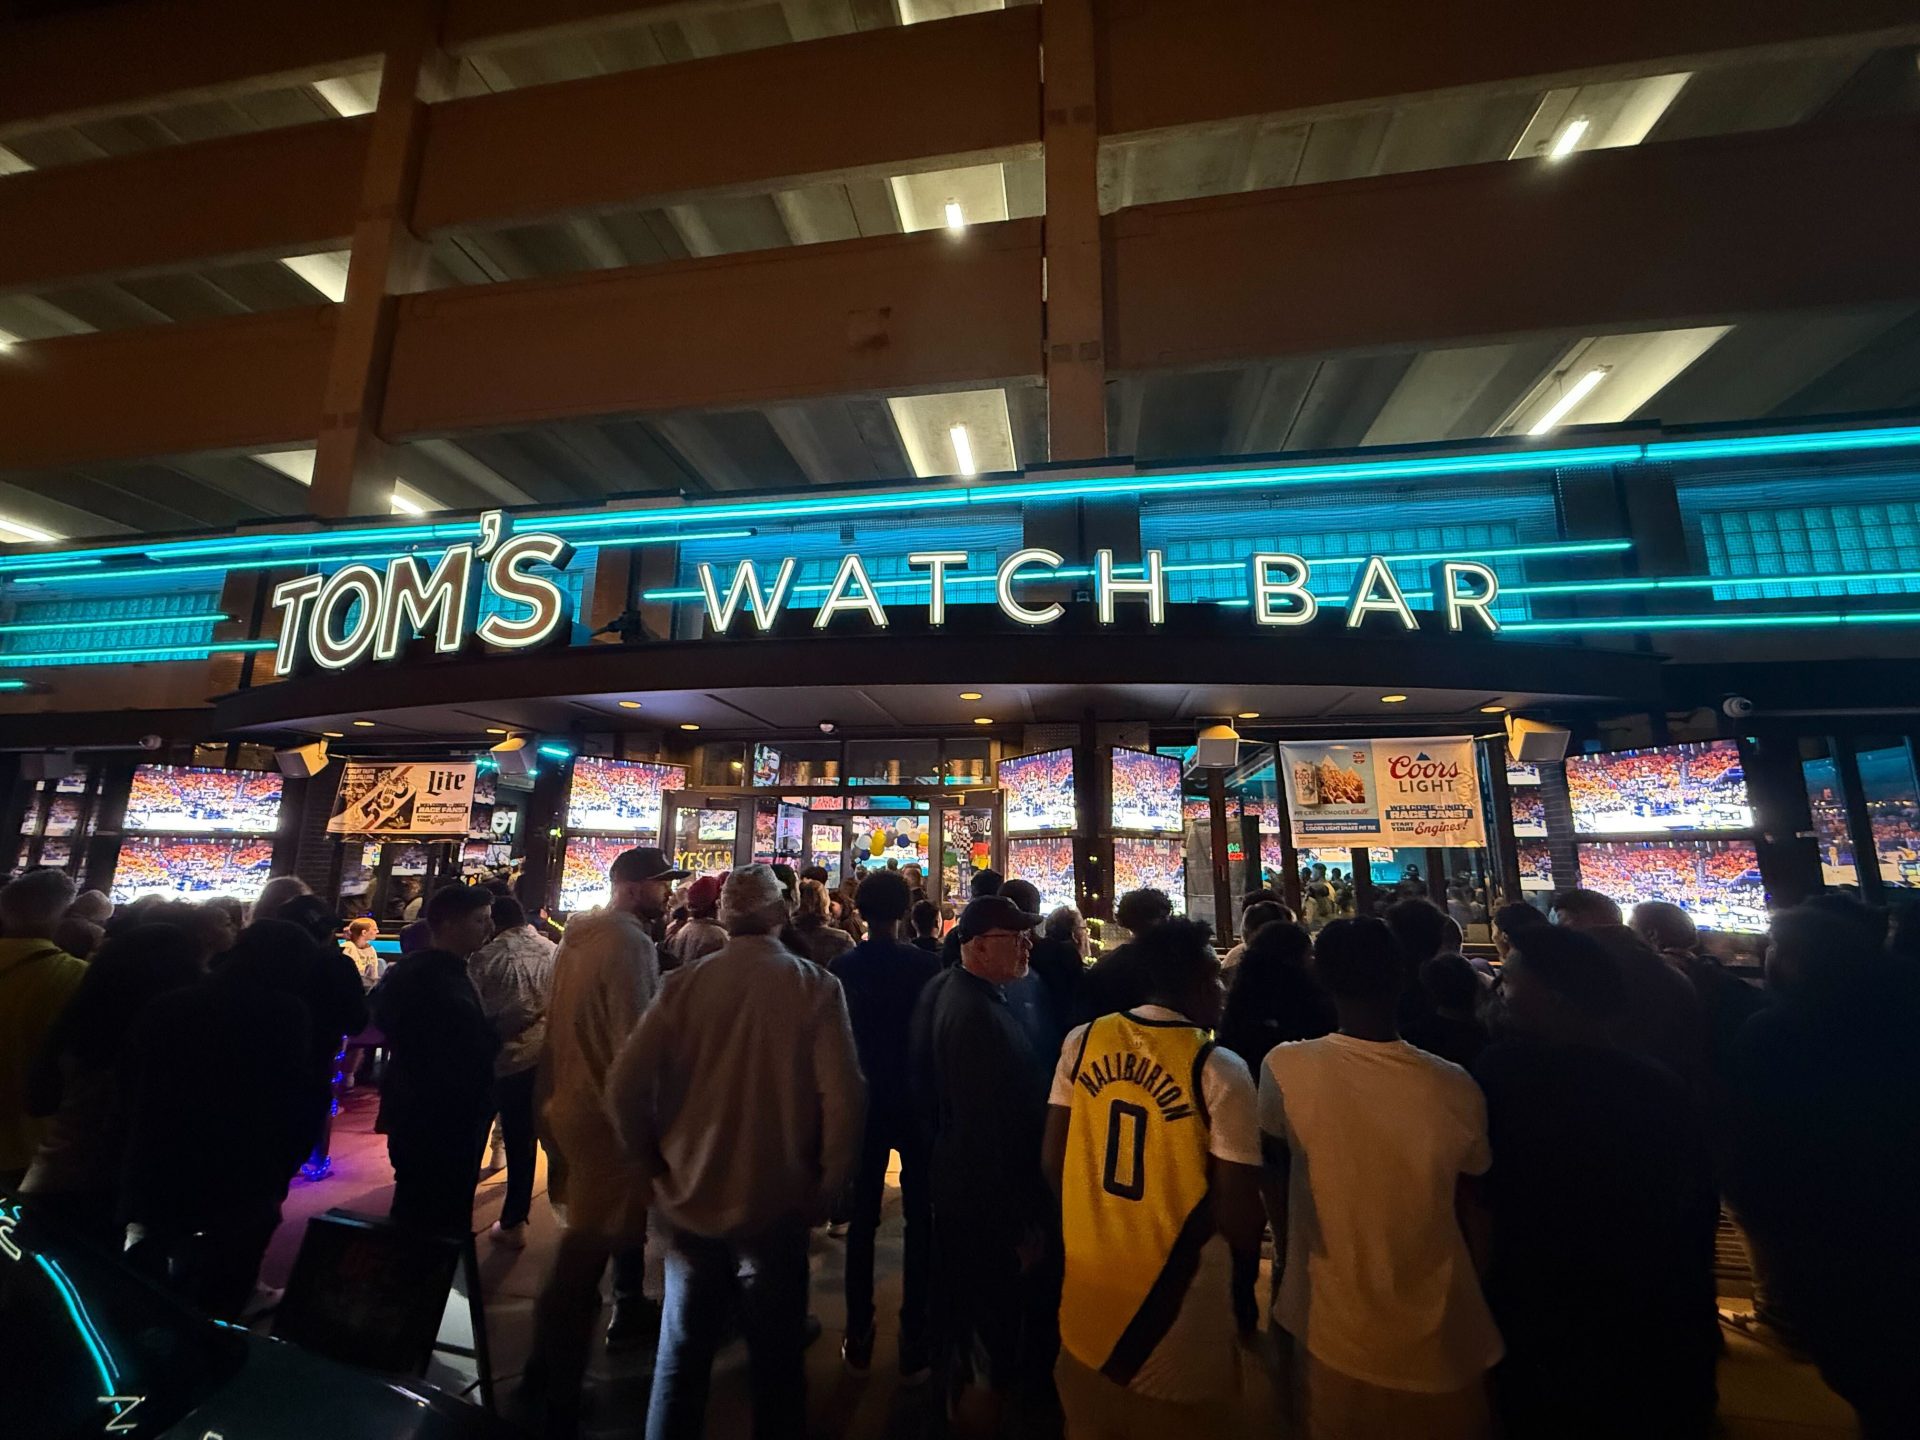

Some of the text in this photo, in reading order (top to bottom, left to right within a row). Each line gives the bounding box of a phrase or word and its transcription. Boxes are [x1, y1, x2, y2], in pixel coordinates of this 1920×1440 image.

[272, 509, 568, 677] TOM'S
[698, 548, 1502, 633] WATCH BAR
[1388, 755, 1459, 779] Coors
[426, 771, 466, 796] Lite
[1399, 780, 1454, 793] LIGHT
[970, 818, 992, 833] 500
[1390, 810, 1468, 819] RACE FANS!
[1414, 820, 1468, 836] Engines!
[1078, 1052, 1192, 1122] HALIBURTON
[1103, 1098, 1148, 1201] 0
